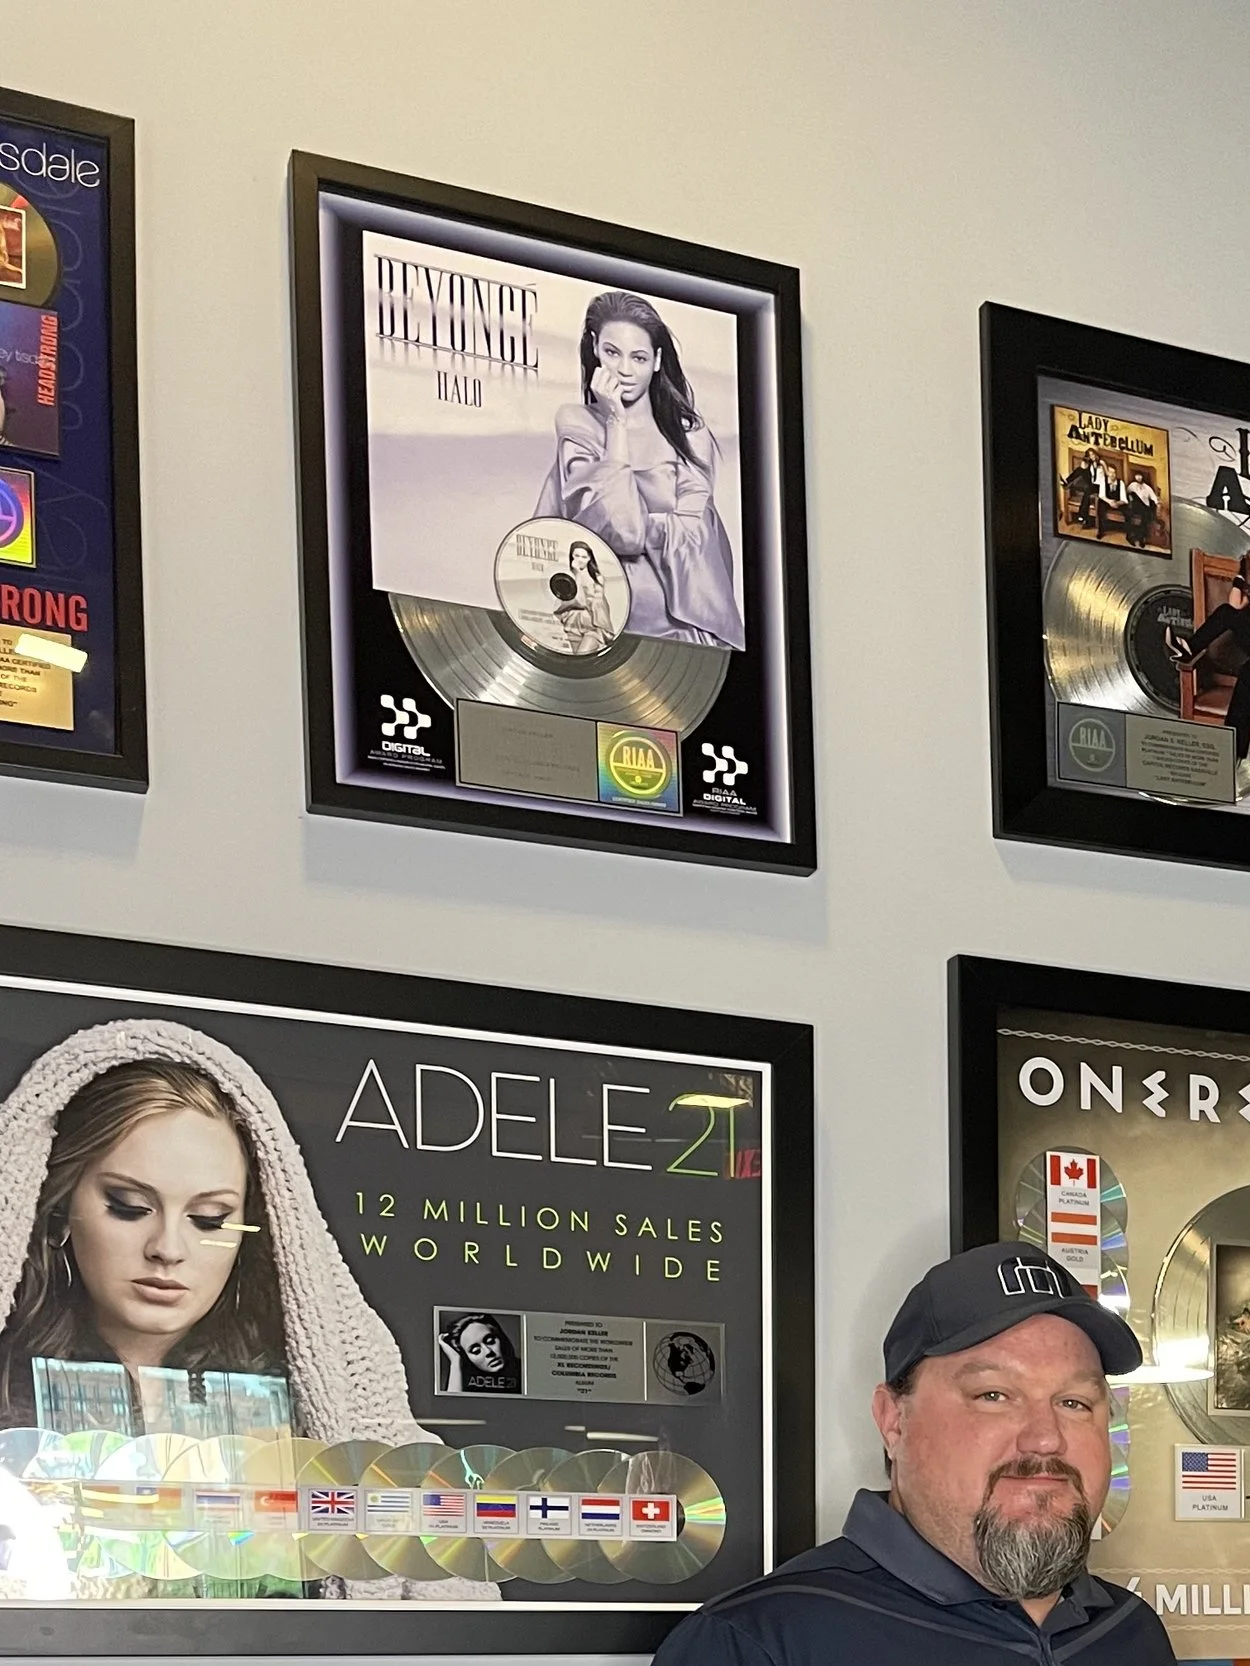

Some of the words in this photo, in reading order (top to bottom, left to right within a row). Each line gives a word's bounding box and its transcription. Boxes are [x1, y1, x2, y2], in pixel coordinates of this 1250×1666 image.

[37, 314, 58, 406] HEADSTRONG
[437, 370, 482, 408] HALO
[1079, 410, 1110, 433] LADY
[1078, 726, 1107, 749] RIAA
[622, 745, 656, 770] RIAA
[703, 793, 747, 807] DIGITAL
[334, 1058, 653, 1171] ADELE
[666, 1093, 736, 1179] 21
[355, 1191, 396, 1218] 12
[422, 1198, 590, 1233] MILLION
[614, 1212, 724, 1244] SALES
[360, 1232, 721, 1282] WORLDWIDE
[468, 1375, 504, 1389] ADELE
[1192, 1503, 1229, 1512] PLATINUM
[1201, 1494, 1217, 1502] USA
